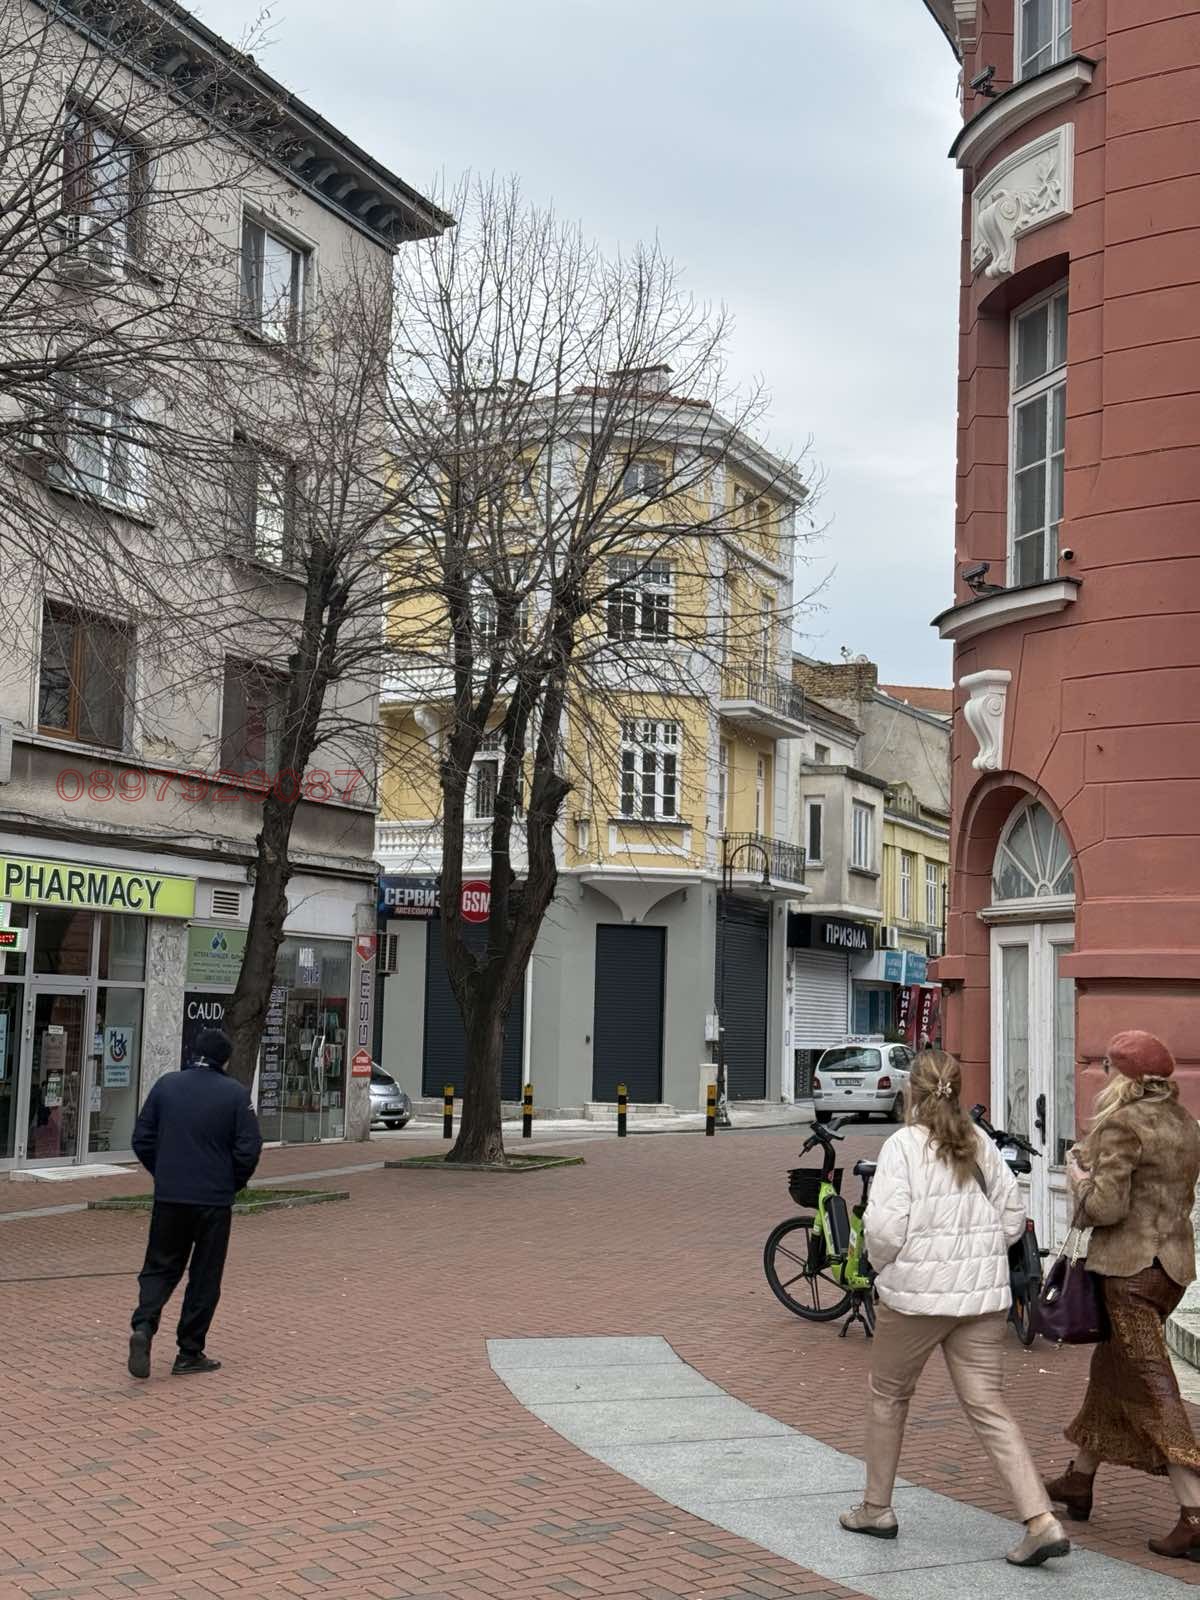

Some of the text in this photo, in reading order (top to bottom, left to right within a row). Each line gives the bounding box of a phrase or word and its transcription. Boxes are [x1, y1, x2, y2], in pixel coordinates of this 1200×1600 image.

[5, 863, 161, 909] PHARMACY
[462, 891, 491, 912] GSM
[826, 923, 867, 948] ПРИЗМА
